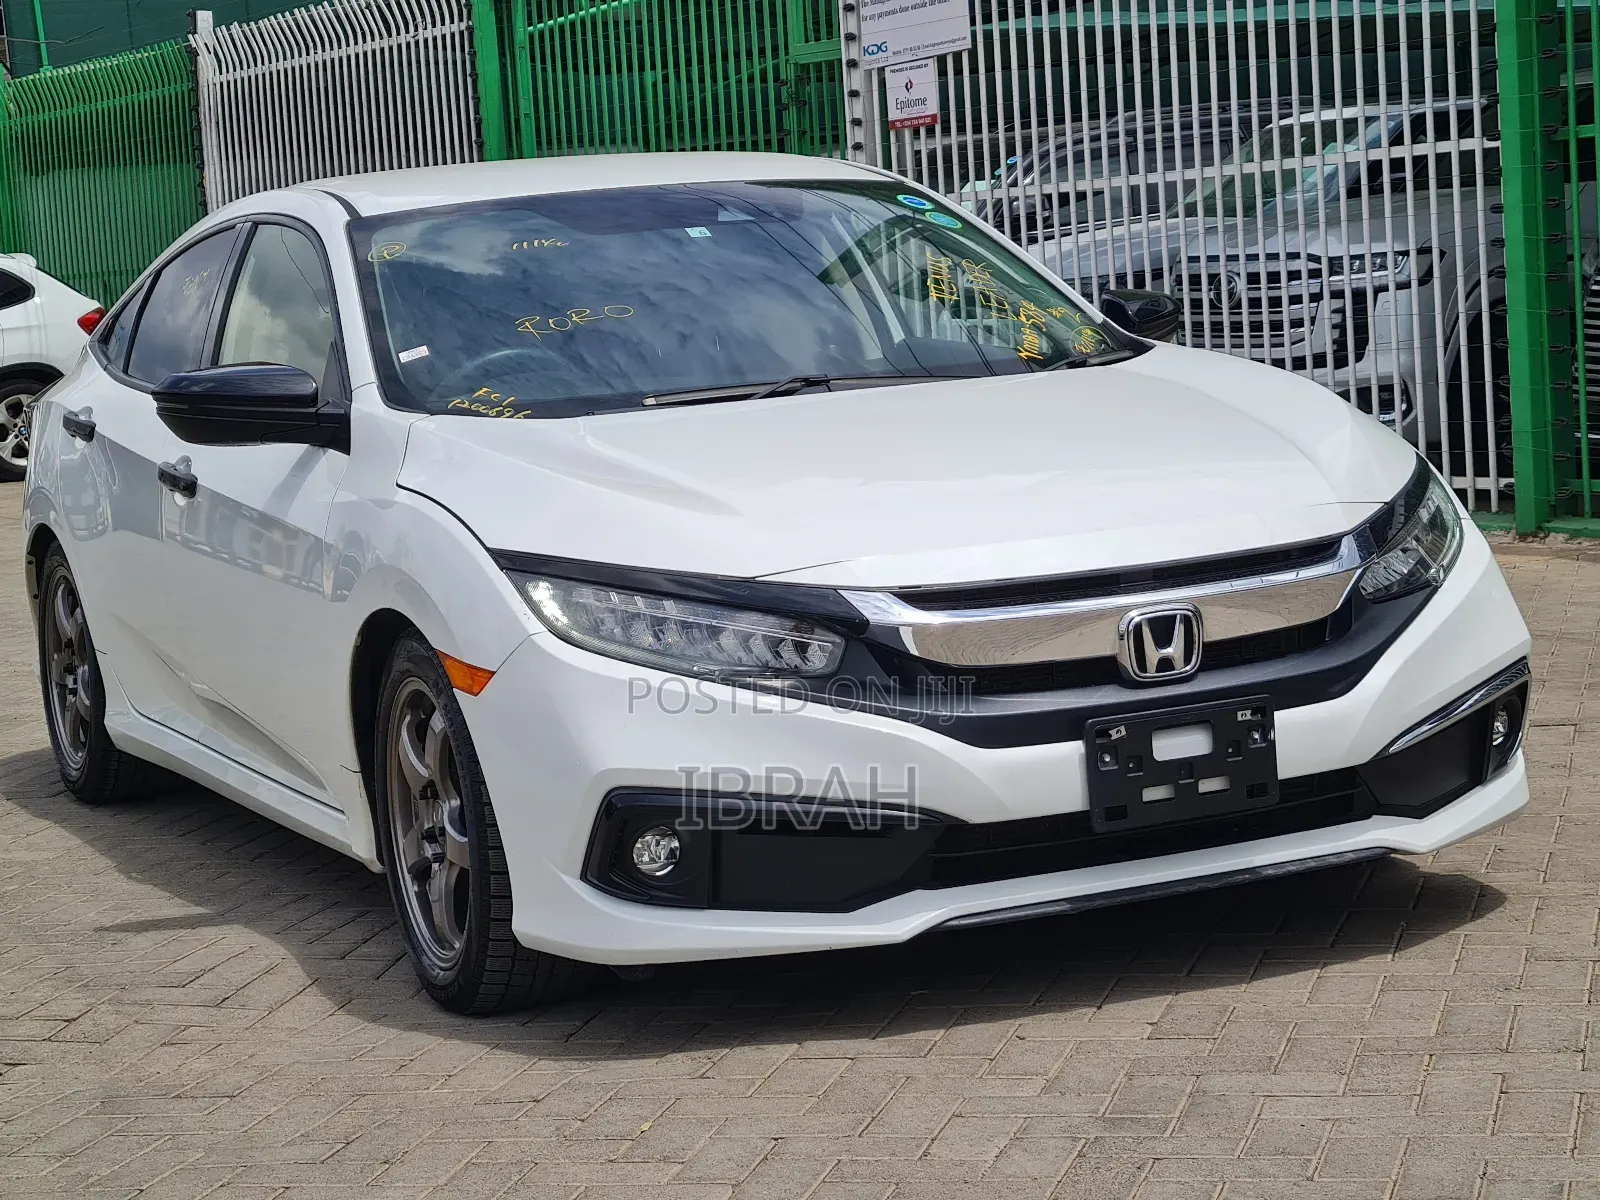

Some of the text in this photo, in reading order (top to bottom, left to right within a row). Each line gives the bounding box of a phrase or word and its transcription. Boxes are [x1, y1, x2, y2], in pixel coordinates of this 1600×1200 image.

[877, 8, 899, 20] payments
[899, 5, 910, 13] done
[895, 96, 928, 114] Epitome
[516, 305, 634, 341] RORO
